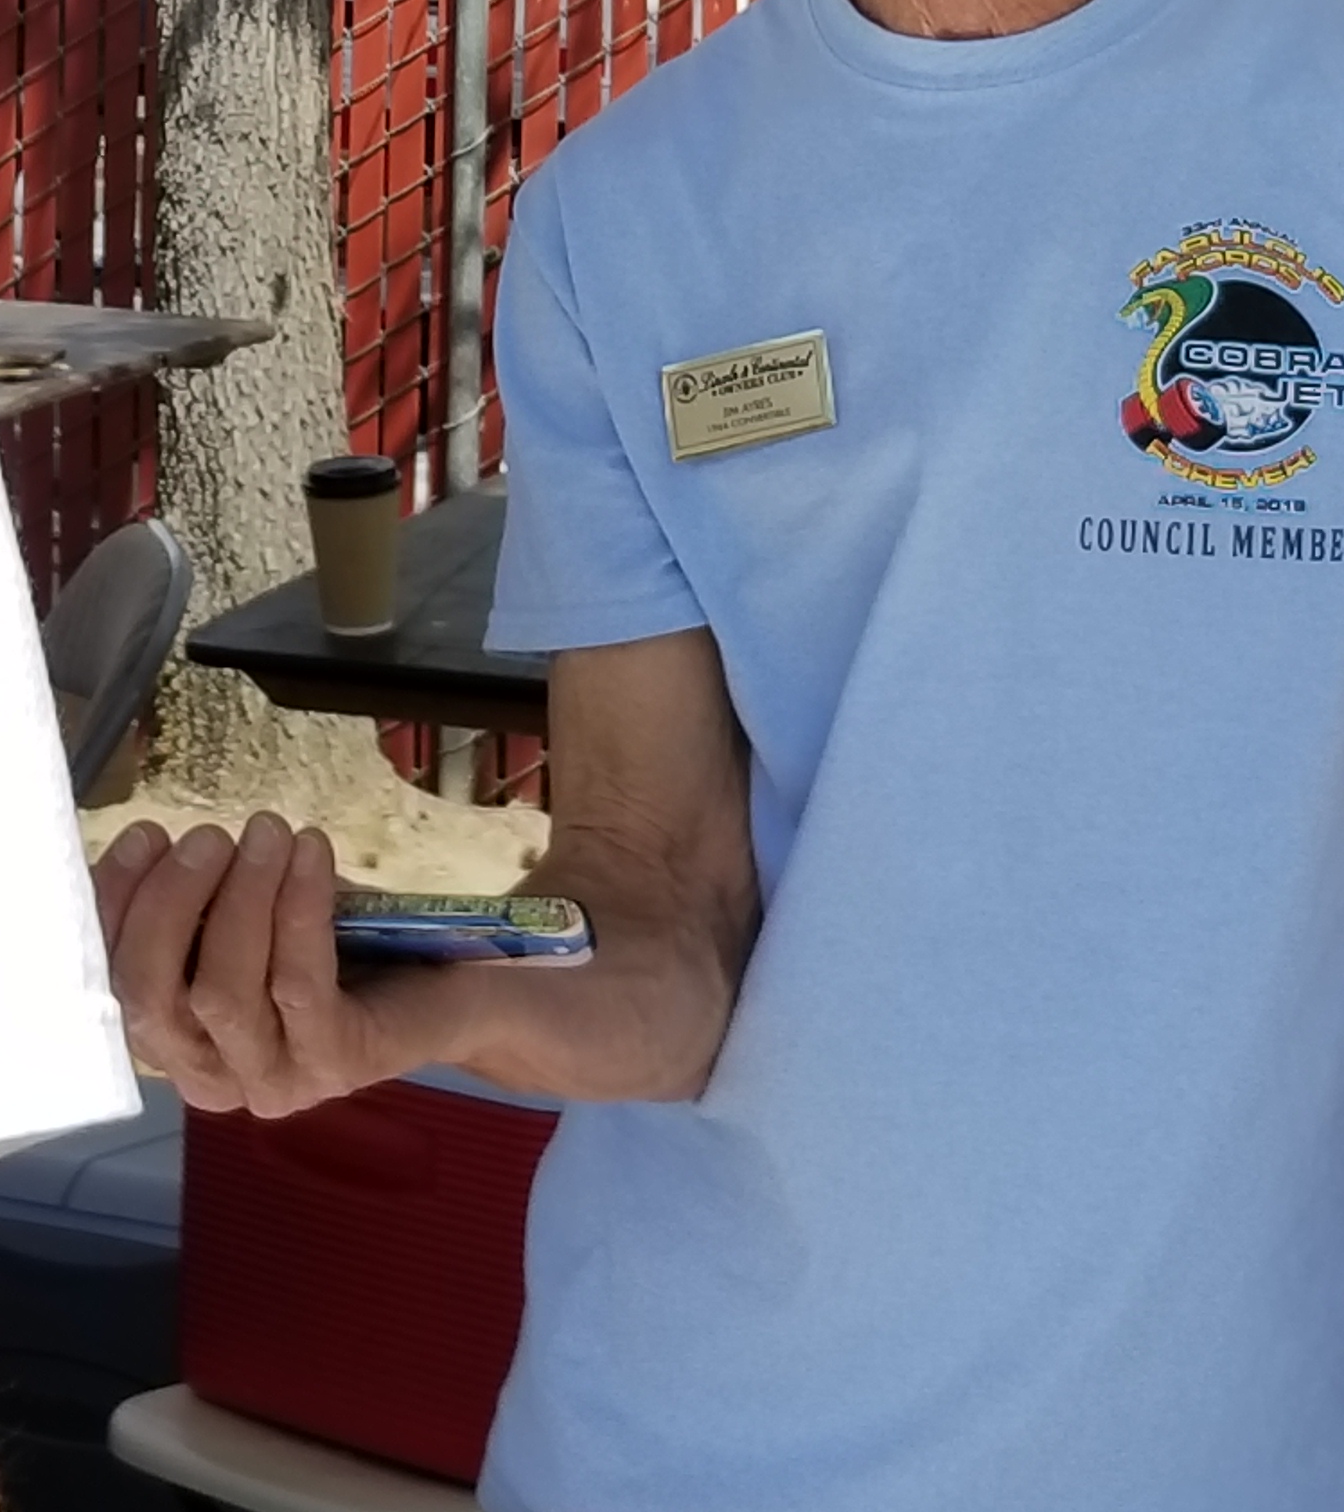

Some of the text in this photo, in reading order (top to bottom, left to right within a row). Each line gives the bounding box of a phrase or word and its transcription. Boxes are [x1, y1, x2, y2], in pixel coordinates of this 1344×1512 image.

[1229, 217, 1298, 245] ANNUAL
[1174, 249, 1303, 290] FORDS
[1146, 438, 1318, 489] FOREVER!
[1158, 494, 1212, 508] APRIL
[1079, 516, 1216, 556] COUNCIL
